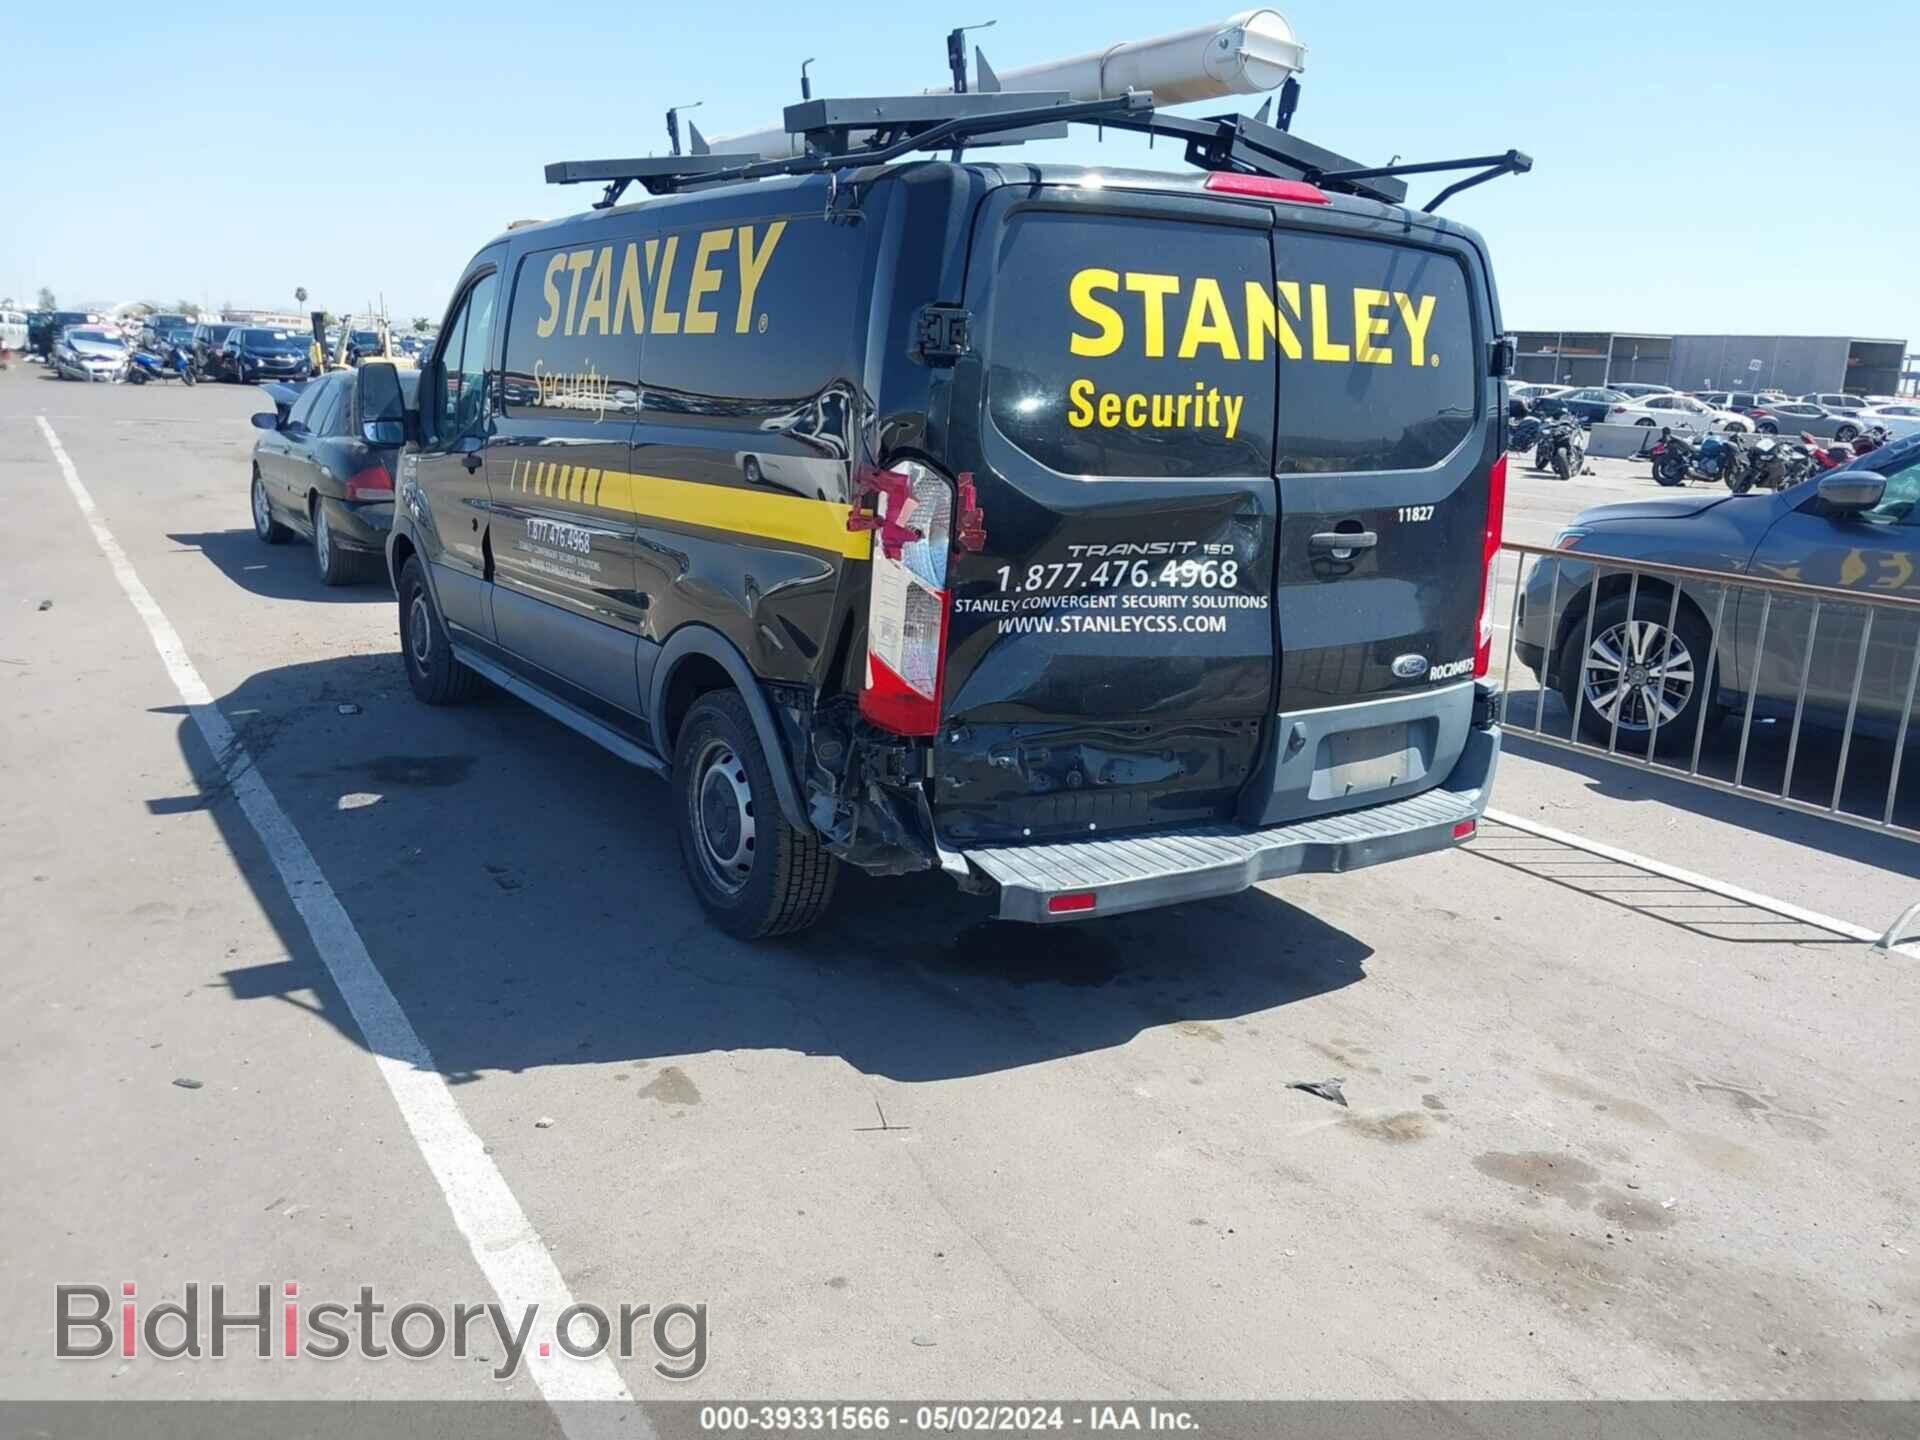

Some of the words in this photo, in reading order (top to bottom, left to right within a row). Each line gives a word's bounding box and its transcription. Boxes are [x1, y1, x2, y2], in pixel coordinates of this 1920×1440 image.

[533, 358, 608, 424] Security
[1068, 379, 1243, 439] Security
[1398, 505, 1435, 523] 11827
[1068, 541, 1198, 558] TRANSIT
[1203, 543, 1234, 556] 150
[997, 559, 1238, 592] 1.877.476.4968
[955, 599, 1021, 613] STANLEY
[1021, 595, 1118, 610] CONVERGENT
[1121, 595, 1188, 609] SECURITY
[1191, 595, 1268, 609] SOLUTIONS
[997, 615, 1227, 634] WWW.STANLEYCSS.COM
